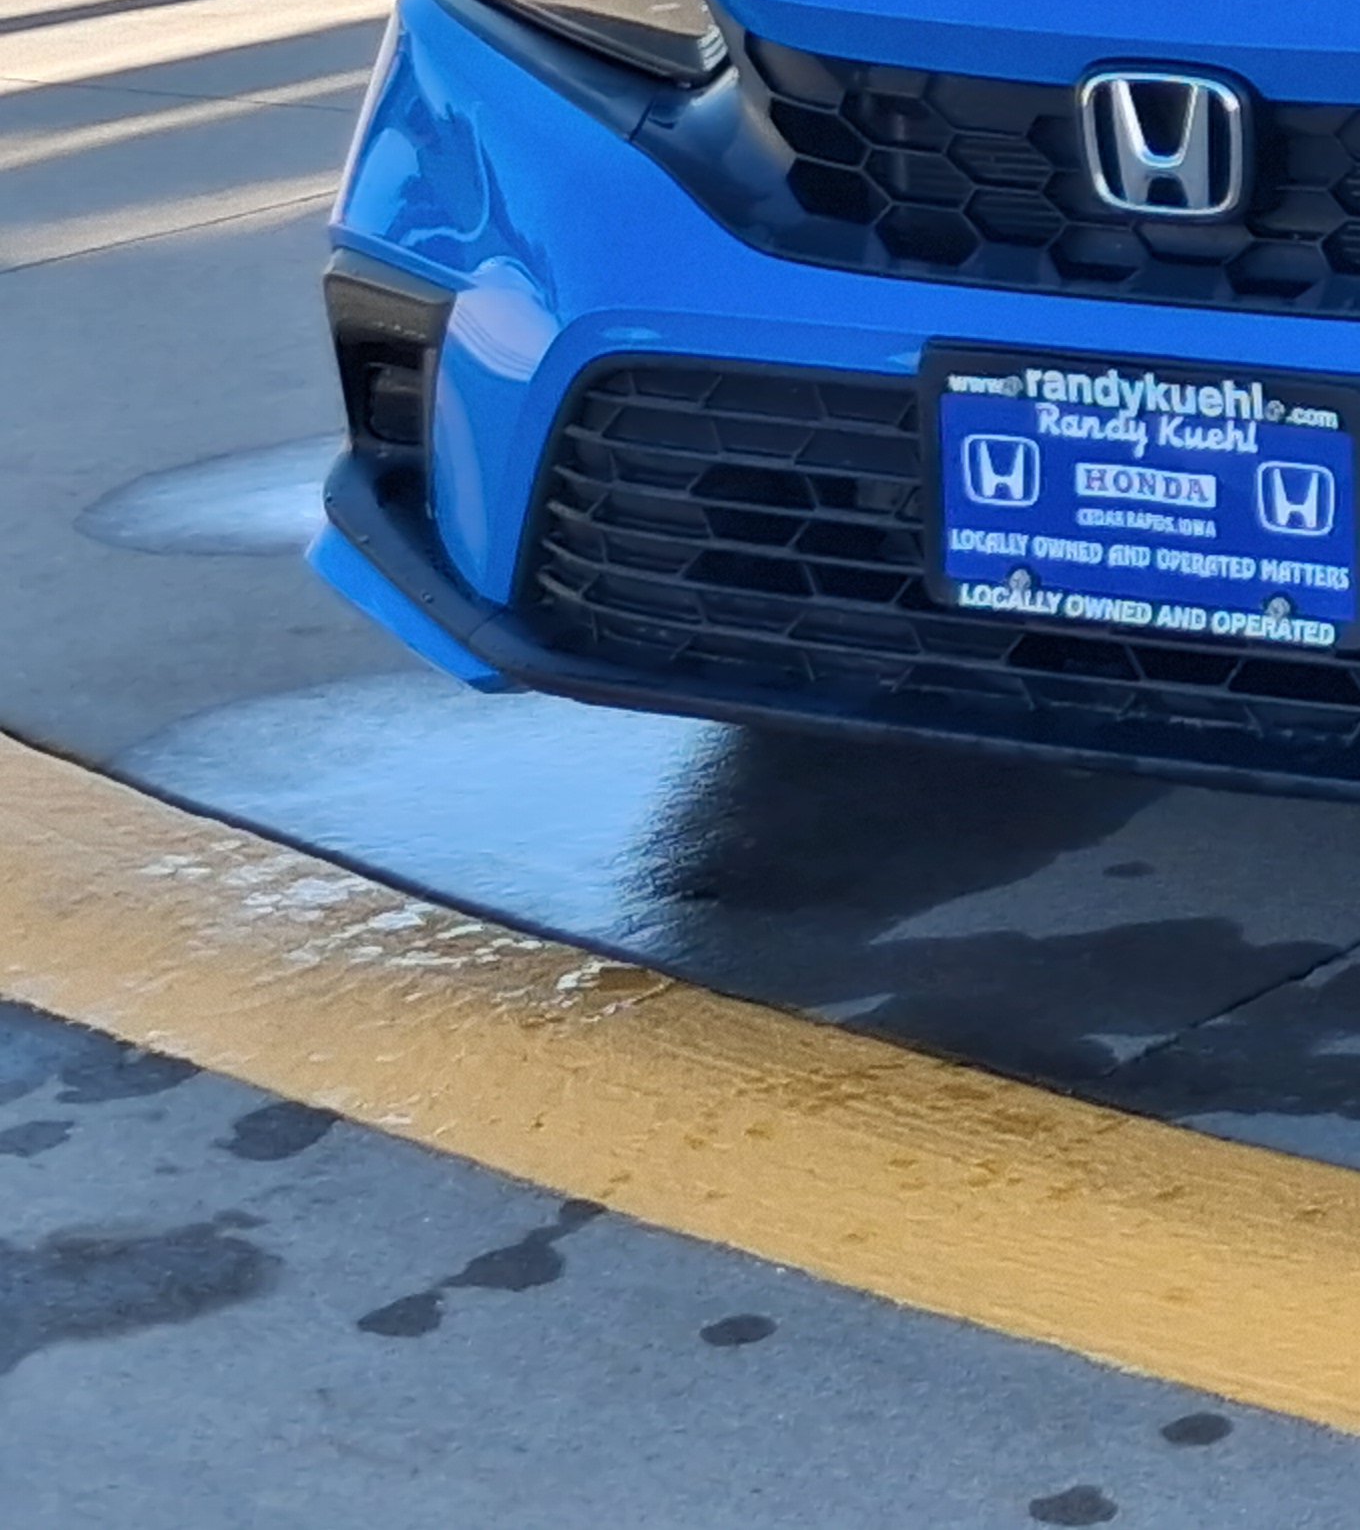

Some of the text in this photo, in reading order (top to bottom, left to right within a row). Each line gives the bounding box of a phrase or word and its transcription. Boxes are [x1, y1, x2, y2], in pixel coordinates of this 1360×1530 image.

[1037, 403, 1259, 458] Randy Kuehl
[1084, 468, 1209, 503] HONDA
[951, 528, 1351, 590] LOCALLY OWNED AND OPERATED MATTERS
[960, 582, 1337, 647] LOCALLY OWNED AND OPERATED
